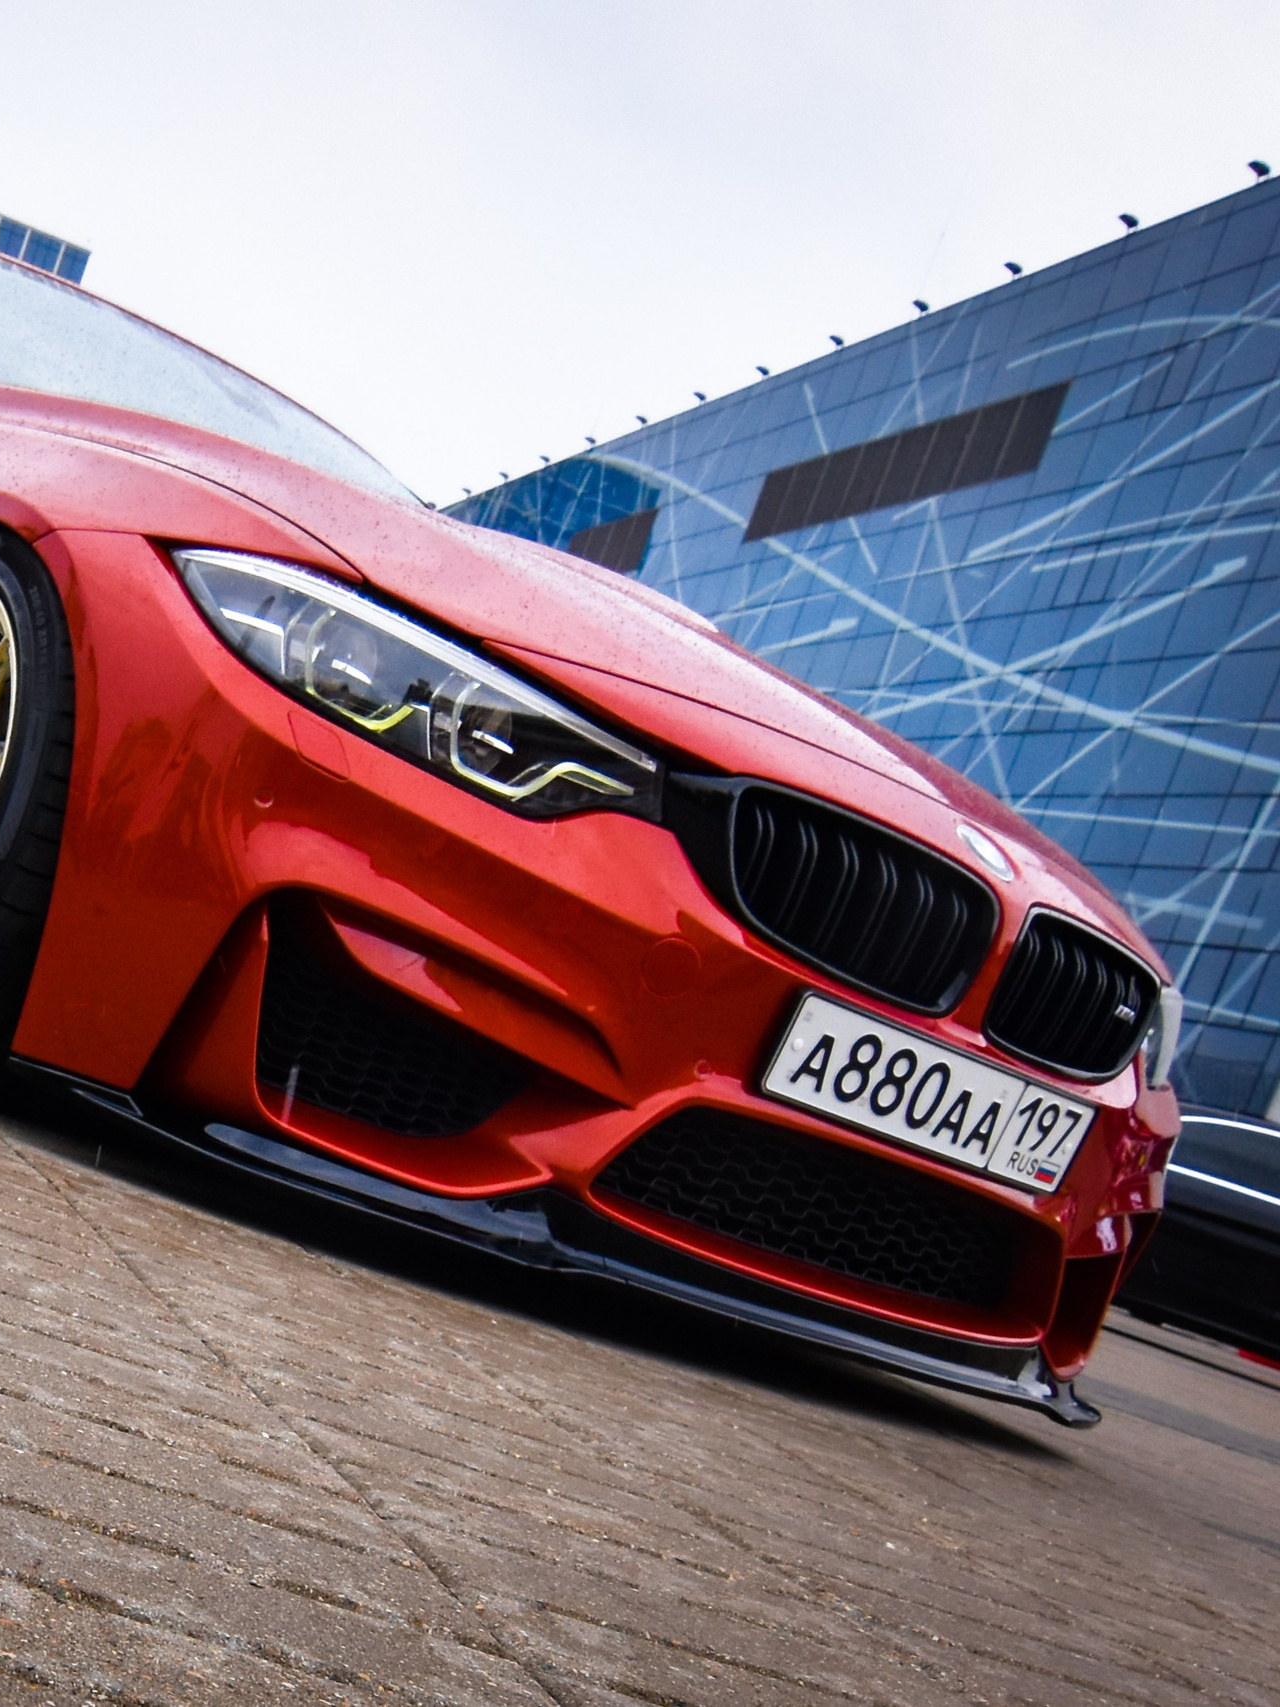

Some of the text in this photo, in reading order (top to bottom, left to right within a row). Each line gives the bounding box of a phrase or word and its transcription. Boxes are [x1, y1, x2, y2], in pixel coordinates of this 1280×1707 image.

[789, 1033, 1083, 1158] A880AA 197
[1006, 1151, 1039, 1176] RUS
